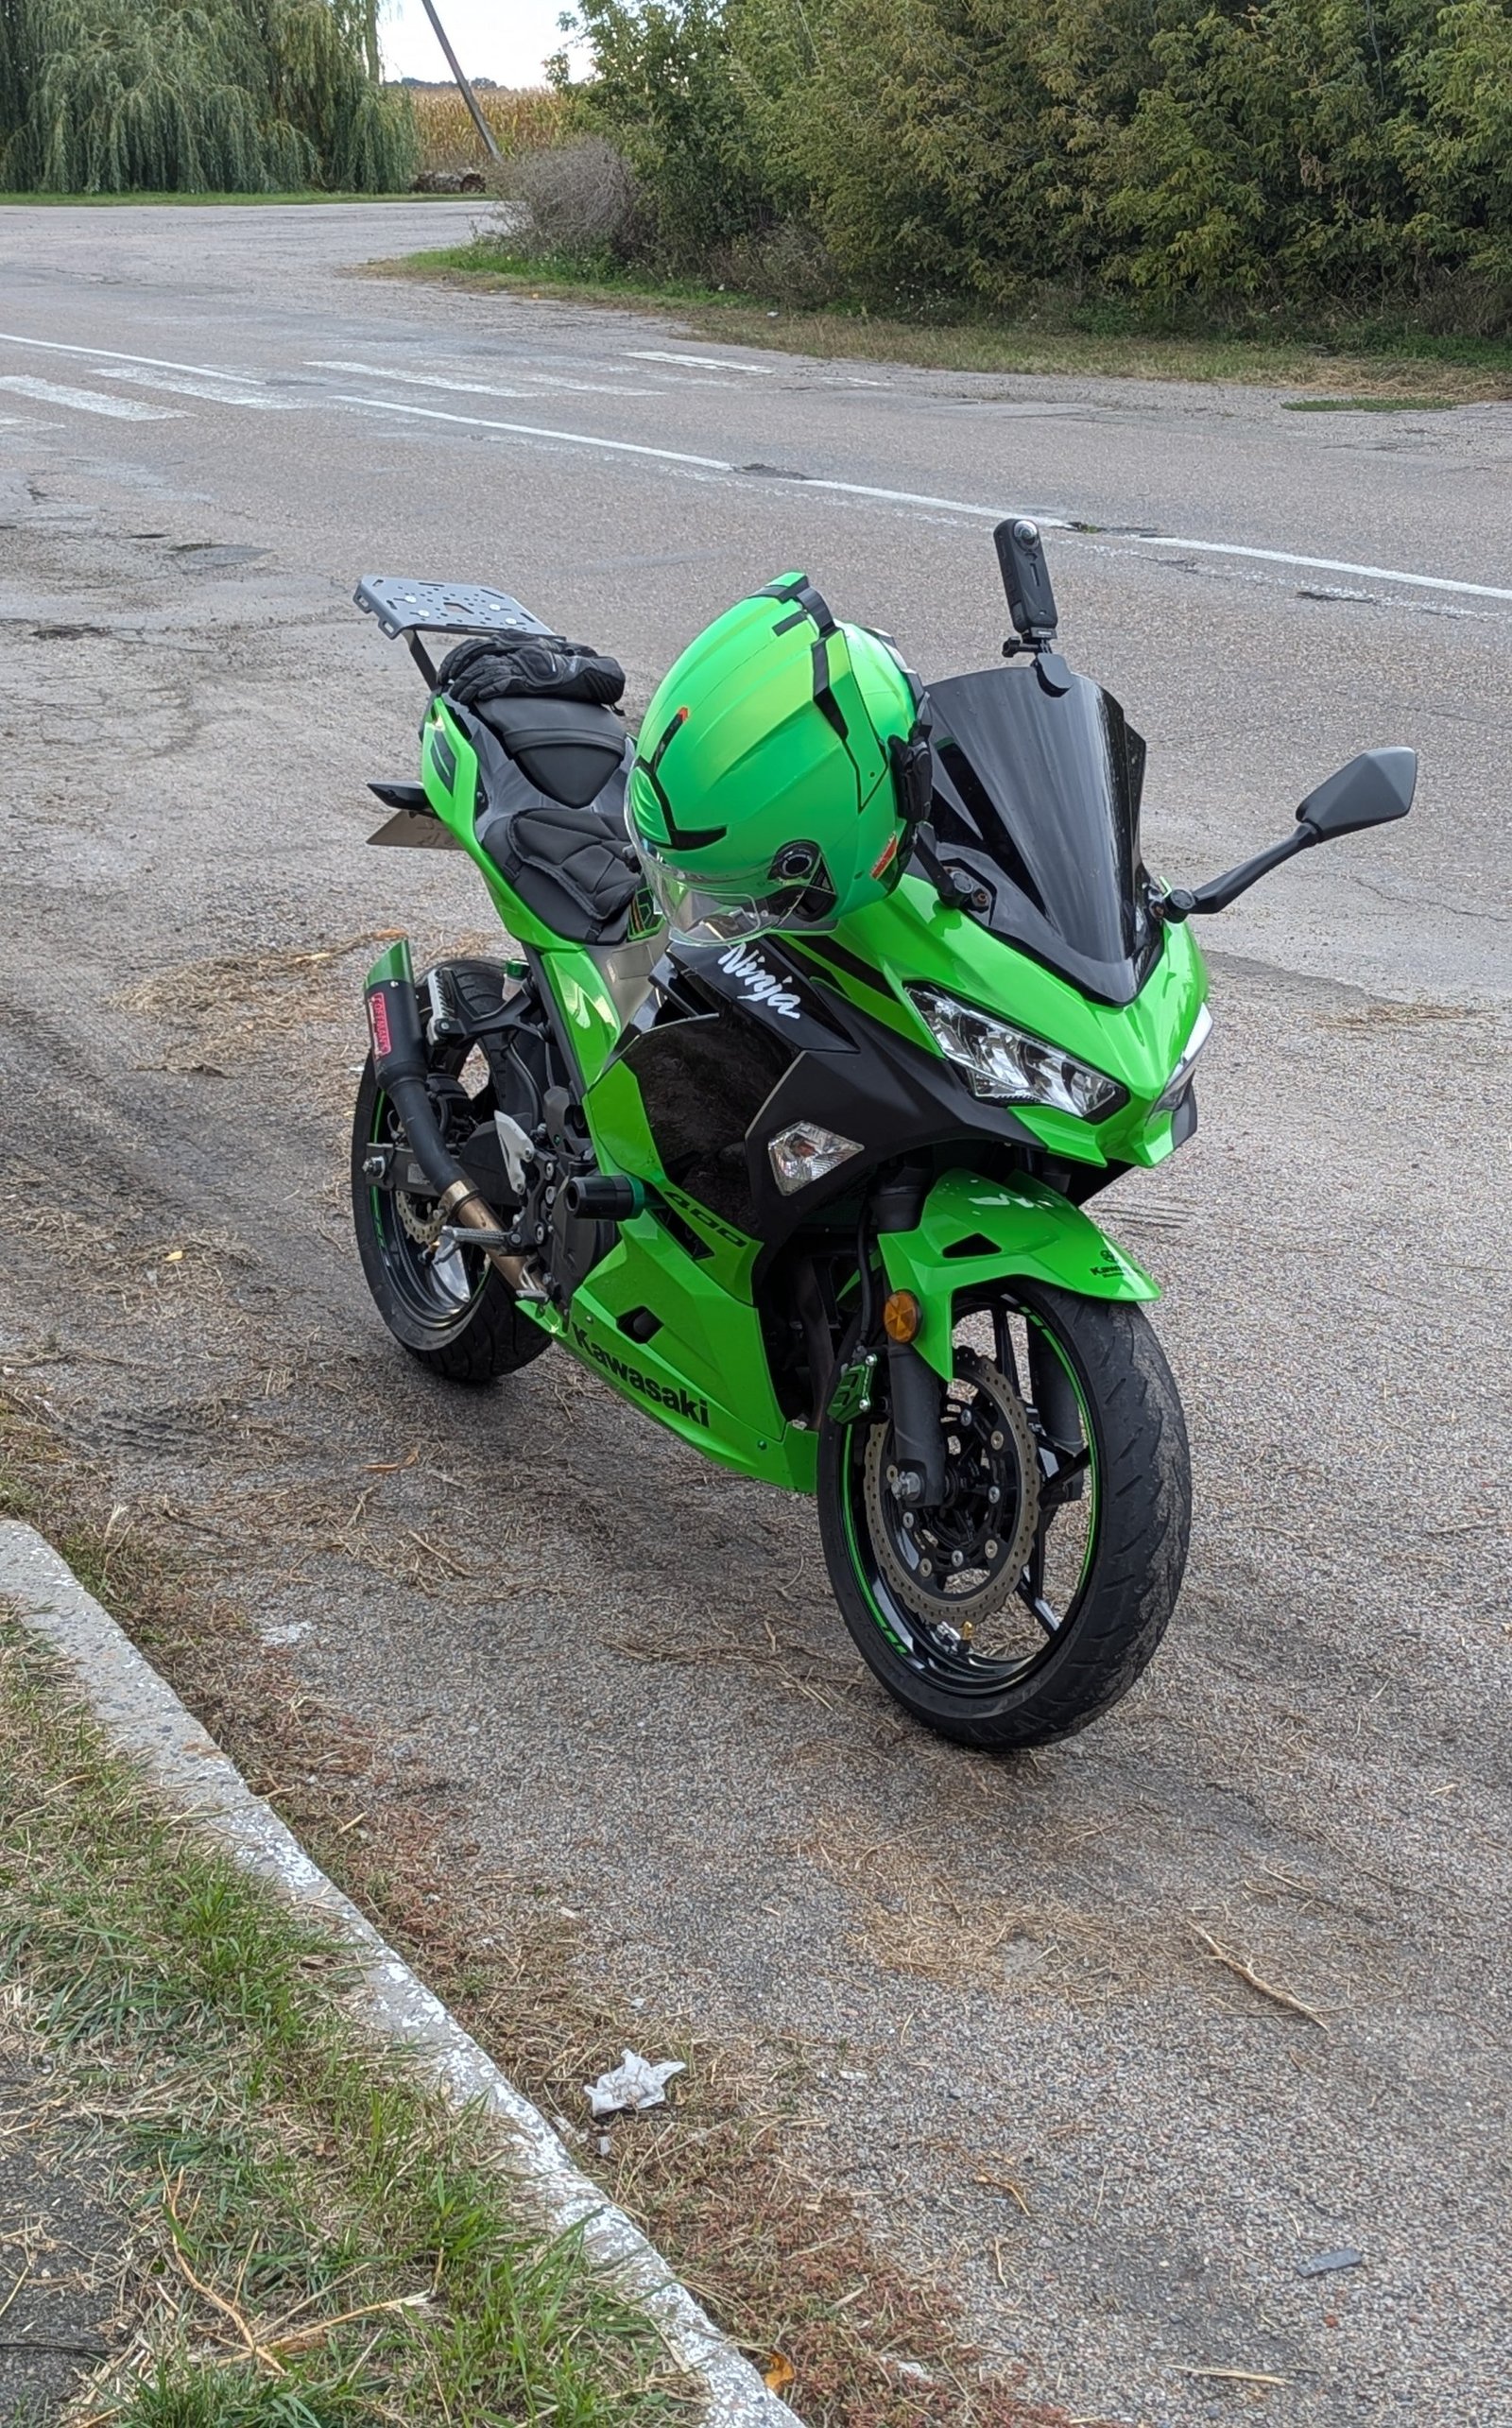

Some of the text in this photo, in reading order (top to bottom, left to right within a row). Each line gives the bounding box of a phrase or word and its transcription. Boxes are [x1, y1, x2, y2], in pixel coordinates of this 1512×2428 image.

[718, 942, 800, 1019] Ninja
[664, 1191, 747, 1248] 400
[572, 1321, 709, 1428] Kawasaki
